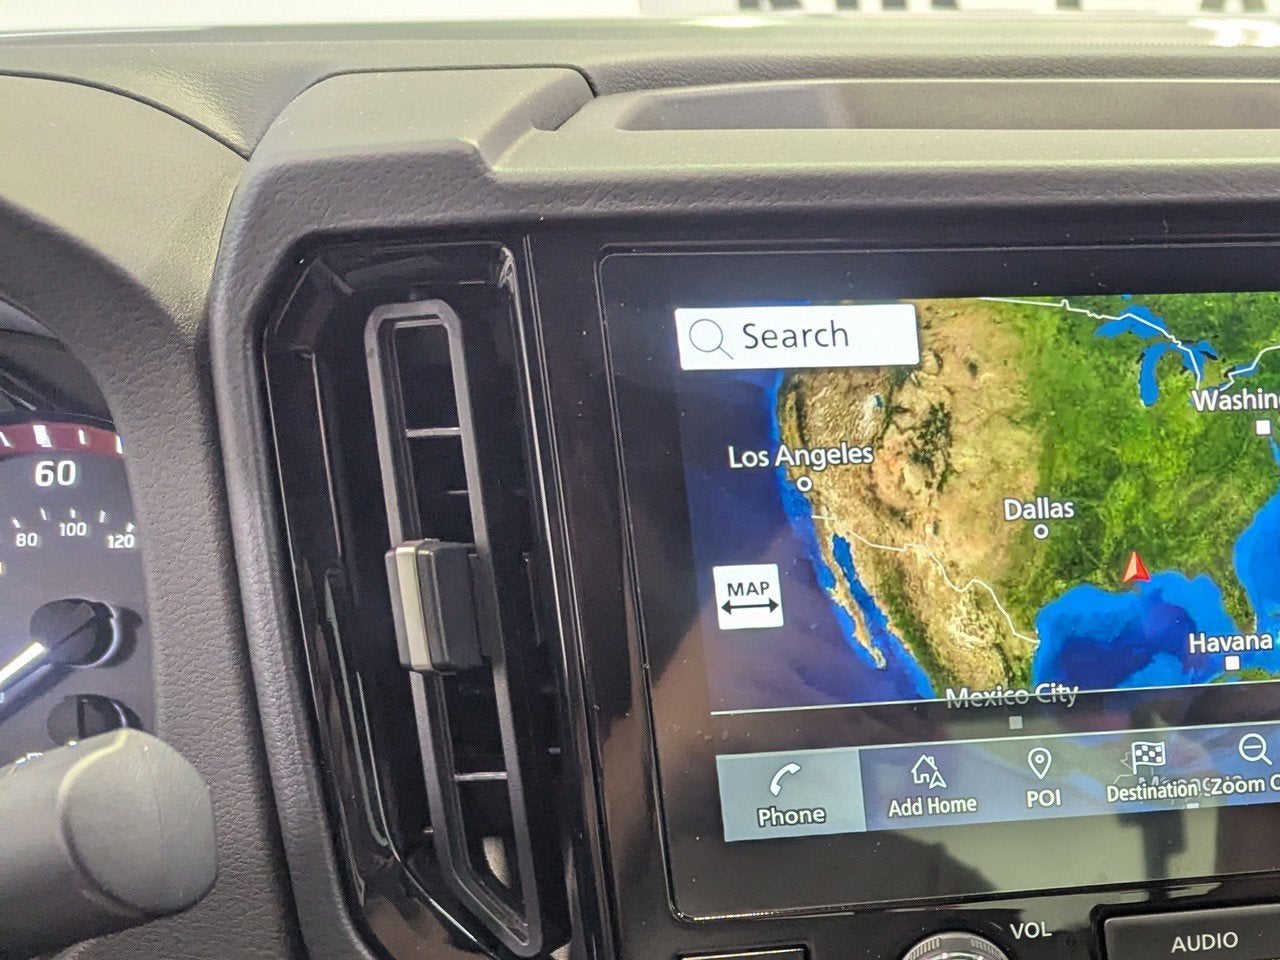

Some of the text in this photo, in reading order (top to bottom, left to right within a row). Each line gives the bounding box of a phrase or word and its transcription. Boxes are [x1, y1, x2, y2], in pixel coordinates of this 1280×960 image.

[742, 319, 850, 349] Search
[728, 443, 874, 471] Los Angeles
[34, 460, 76, 487] 60
[1004, 497, 1075, 521] Dallas
[59, 522, 87, 537] 100
[15, 533, 38, 547] 80
[108, 534, 135, 549] 120
[727, 581, 770, 597] MAP
[1189, 632, 1272, 654] Havana
[946, 683, 1079, 709] Mexico City
[1106, 782, 1198, 802] Destination
[1210, 777, 1265, 795] Zoom
[889, 797, 978, 818] Add Home
[1026, 790, 1061, 808] POI
[758, 807, 826, 827] Phone
[1010, 921, 1052, 940] VOL
[1171, 931, 1239, 954] AUDIO
